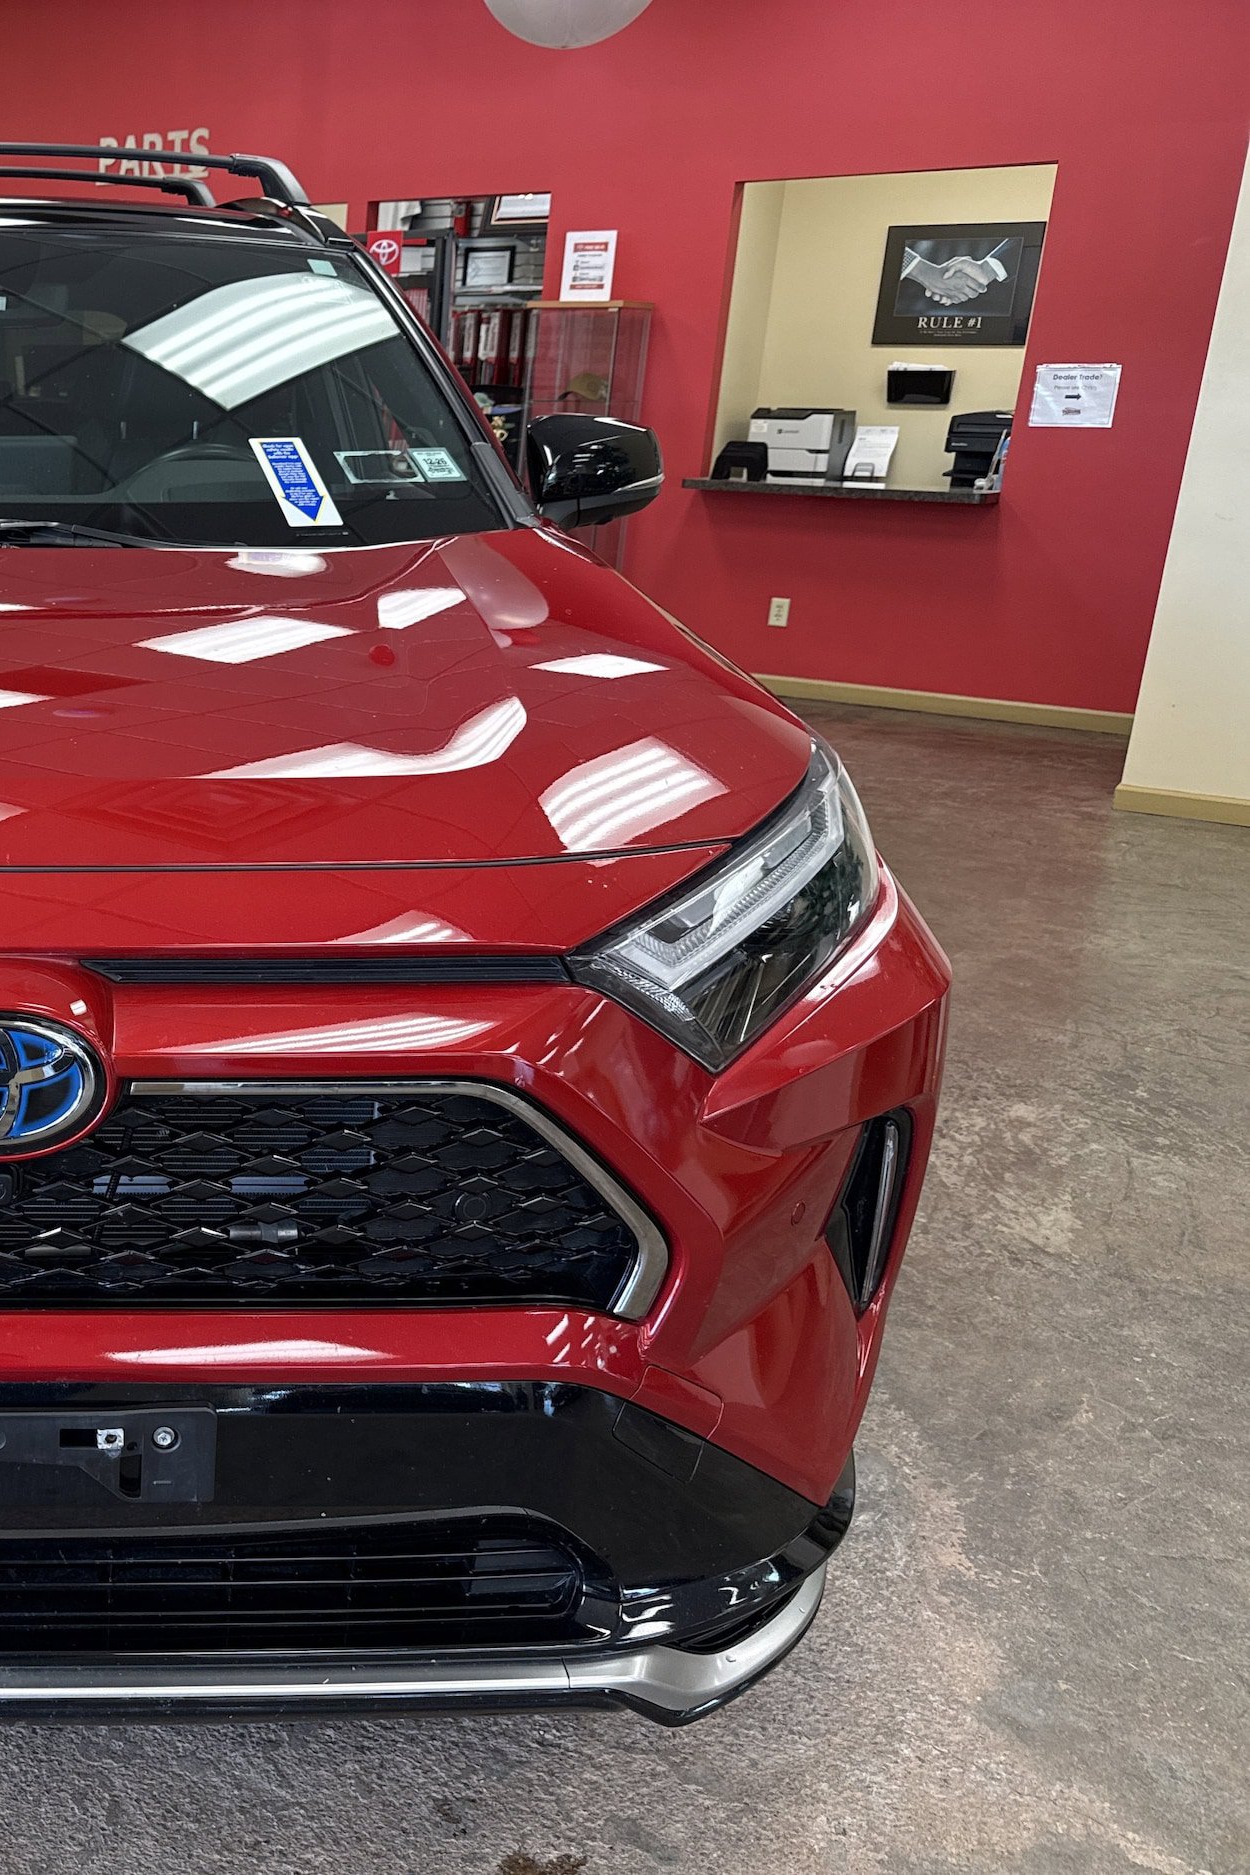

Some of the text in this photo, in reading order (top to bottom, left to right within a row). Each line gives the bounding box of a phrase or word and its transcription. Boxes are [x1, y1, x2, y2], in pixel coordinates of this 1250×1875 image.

[96, 127, 210, 186] PARTS
[917, 316, 982, 329] RULE #1
